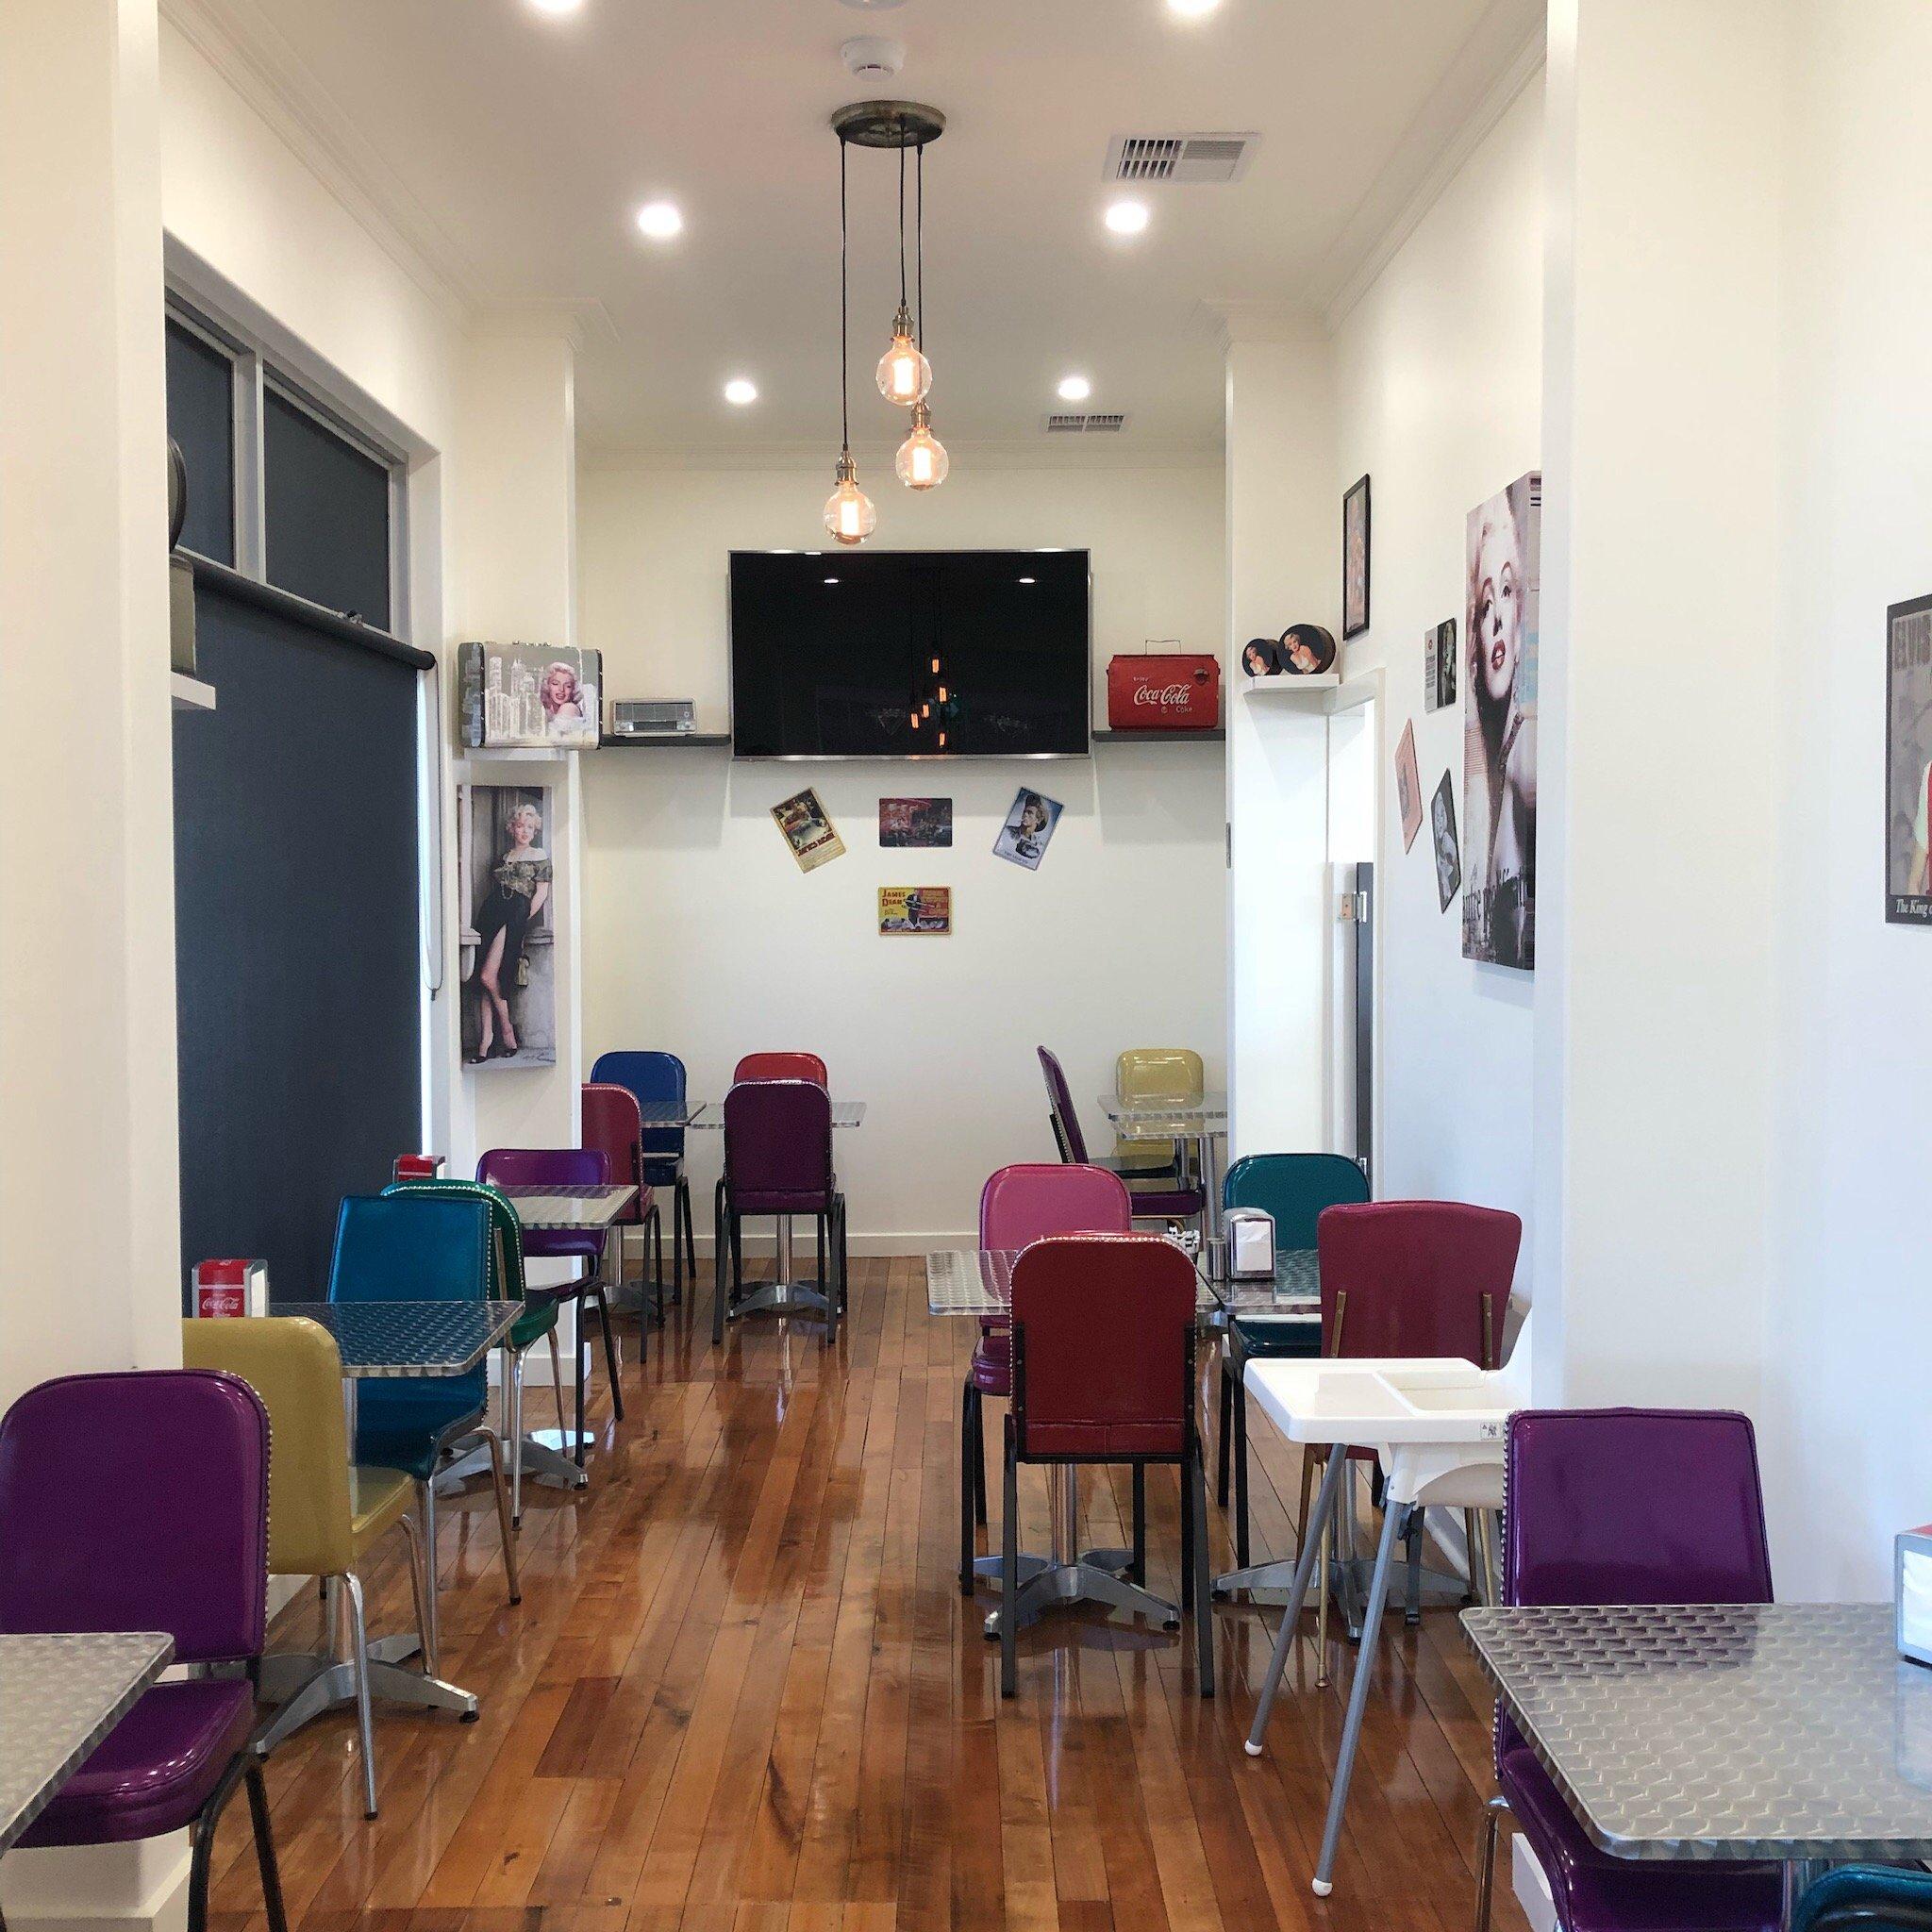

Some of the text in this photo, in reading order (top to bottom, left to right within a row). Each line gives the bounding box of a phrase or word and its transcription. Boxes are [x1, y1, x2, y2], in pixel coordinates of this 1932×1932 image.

[1134, 684, 1192, 705] Coca-Cola
[882, 889, 907, 898] JAMES
[1896, 898, 1909, 914] The
[1909, 899, 1928, 918] King
